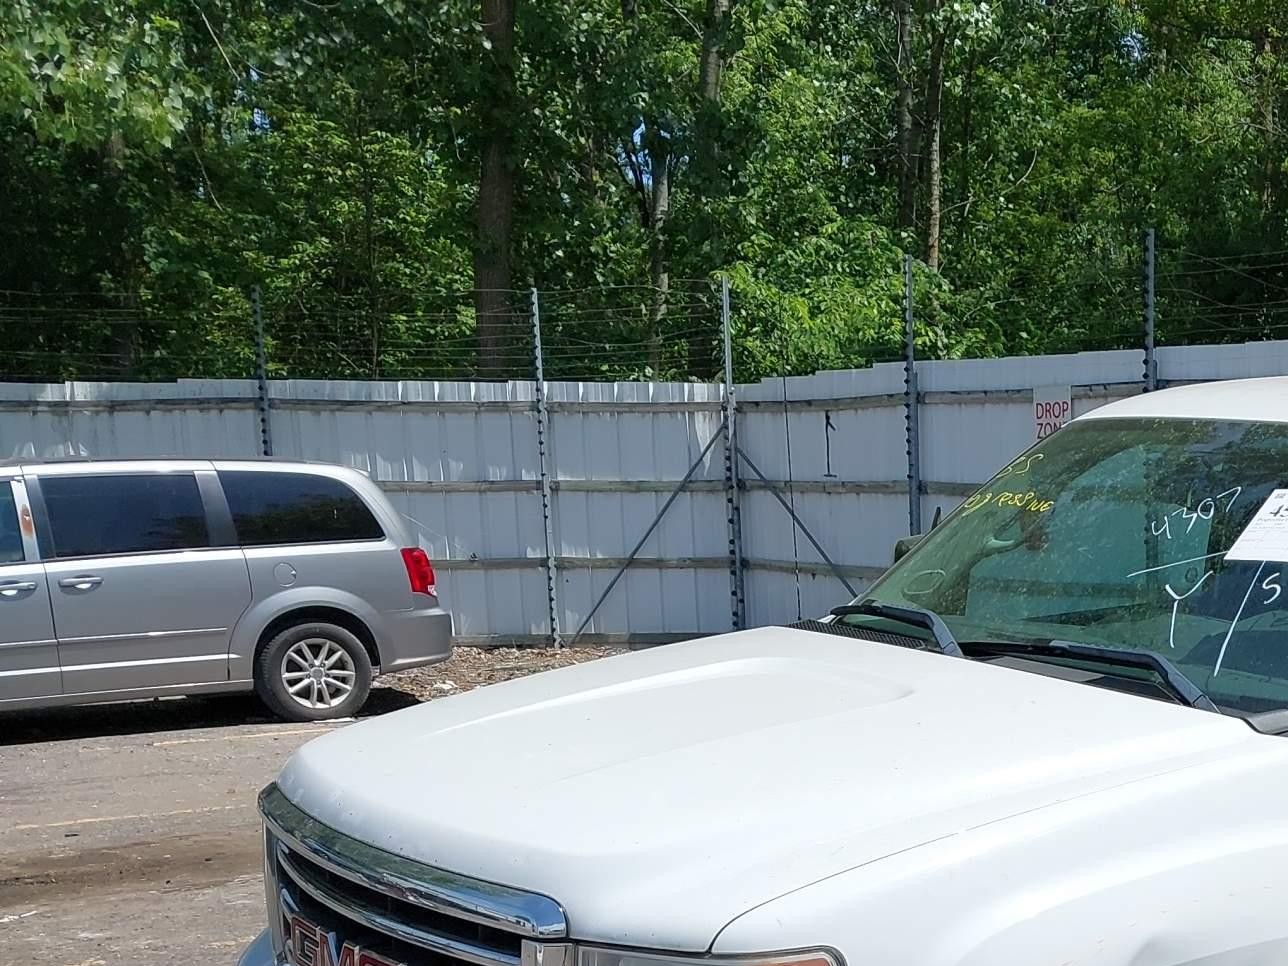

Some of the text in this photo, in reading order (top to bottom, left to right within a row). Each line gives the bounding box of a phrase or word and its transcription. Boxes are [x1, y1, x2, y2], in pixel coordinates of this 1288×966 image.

[1036, 401, 1069, 419] DROP
[1036, 421, 1067, 440] ZON
[1151, 486, 1242, 540] 4307
